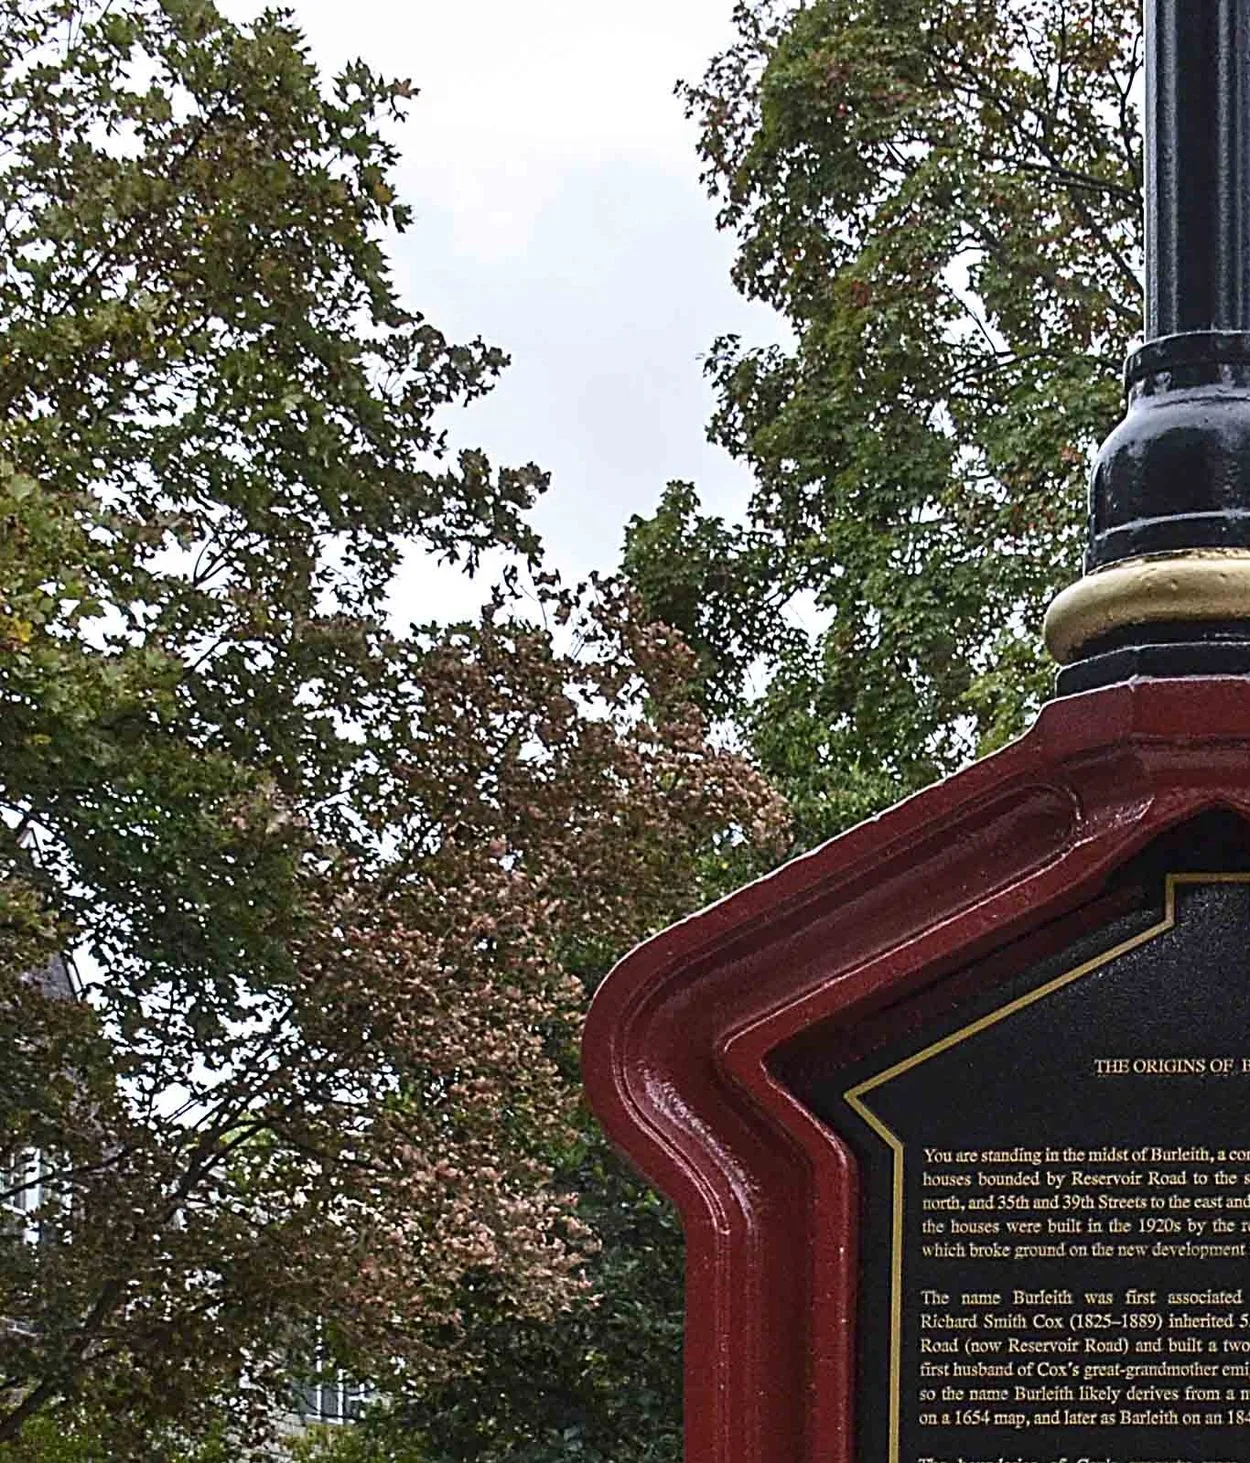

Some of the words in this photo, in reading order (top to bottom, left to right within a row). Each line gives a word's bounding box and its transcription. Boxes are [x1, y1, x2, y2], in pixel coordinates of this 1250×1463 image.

[1095, 1058, 1130, 1073] THE
[1133, 1059, 1205, 1073] ORIGINS
[1210, 1059, 1234, 1073] OF
[924, 1149, 952, 1162] You
[956, 1152, 978, 1162] are
[981, 1148, 1041, 1165] standing
[1045, 1147, 1059, 1162] in
[1063, 1148, 1085, 1161] the
[1089, 1147, 1129, 1161] midst
[1132, 1147, 1149, 1162] of
[1151, 1147, 1214, 1163] Burleith,
[1217, 1151, 1226, 1161] a
[923, 1172, 971, 1186] houses
[978, 1171, 1040, 1186] bounded
[1047, 1171, 1066, 1189] by
[1072, 1171, 1142, 1185] Reservoir
[1148, 1171, 1186, 1185] Road
[1193, 1173, 1208, 1184] to
[1214, 1171, 1237, 1184] the
[923, 1219, 944, 1233] the
[951, 1219, 999, 1233] houses
[1006, 1222, 1041, 1233] were
[1048, 1218, 1082, 1233] built
[1088, 1218, 1103, 1232] in
[1109, 1218, 1131, 1232] the
[1139, 1218, 1181, 1233] 1920s
[1187, 1218, 1206, 1236] by
[1213, 1218, 1235, 1232] the
[923, 1243, 966, 1257] which
[969, 1242, 1010, 1257] broke
[1014, 1242, 1066, 1259] ground
[1069, 1246, 1088, 1256] on
[1092, 1242, 1113, 1256] the
[1118, 1245, 1148, 1256] new
[1152, 1242, 1245, 1259] development
[921, 1290, 949, 1304] The
[962, 1294, 1001, 1304] name
[1013, 1290, 1072, 1304] Burleith
[1085, 1293, 1113, 1304] was
[1126, 1289, 1155, 1304] first
[1168, 1289, 1242, 1304] associated
[921, 1338, 958, 1352] Road
[965, 1339, 1002, 1355] (now
[1009, 1337, 1079, 1352] Reservoir
[1085, 1338, 1128, 1354] Road)
[1136, 1338, 1162, 1352] and
[1168, 1337, 1202, 1352] built
[1209, 1342, 1217, 1352] a
[920, 1390, 936, 1400] so
[942, 1386, 964, 1400] the
[970, 1390, 1008, 1400] name
[1015, 1386, 1074, 1400] Burleith
[1079, 1386, 1120, 1404] likely
[1127, 1386, 1179, 1400] derives
[1185, 1386, 1220, 1400] from
[1226, 1389, 1235, 1400] a
[919, 1414, 937, 1424] on
[942, 1414, 951, 1424] a
[956, 1410, 990, 1424] 1654
[994, 1414, 1030, 1428] map,
[1034, 1410, 1060, 1424] and
[1064, 1410, 1097, 1424] later
[1101, 1414, 1115, 1424] as
[1120, 1410, 1178, 1424] Barleith
[1183, 1414, 1200, 1424] on
[1205, 1414, 1222, 1424] an
